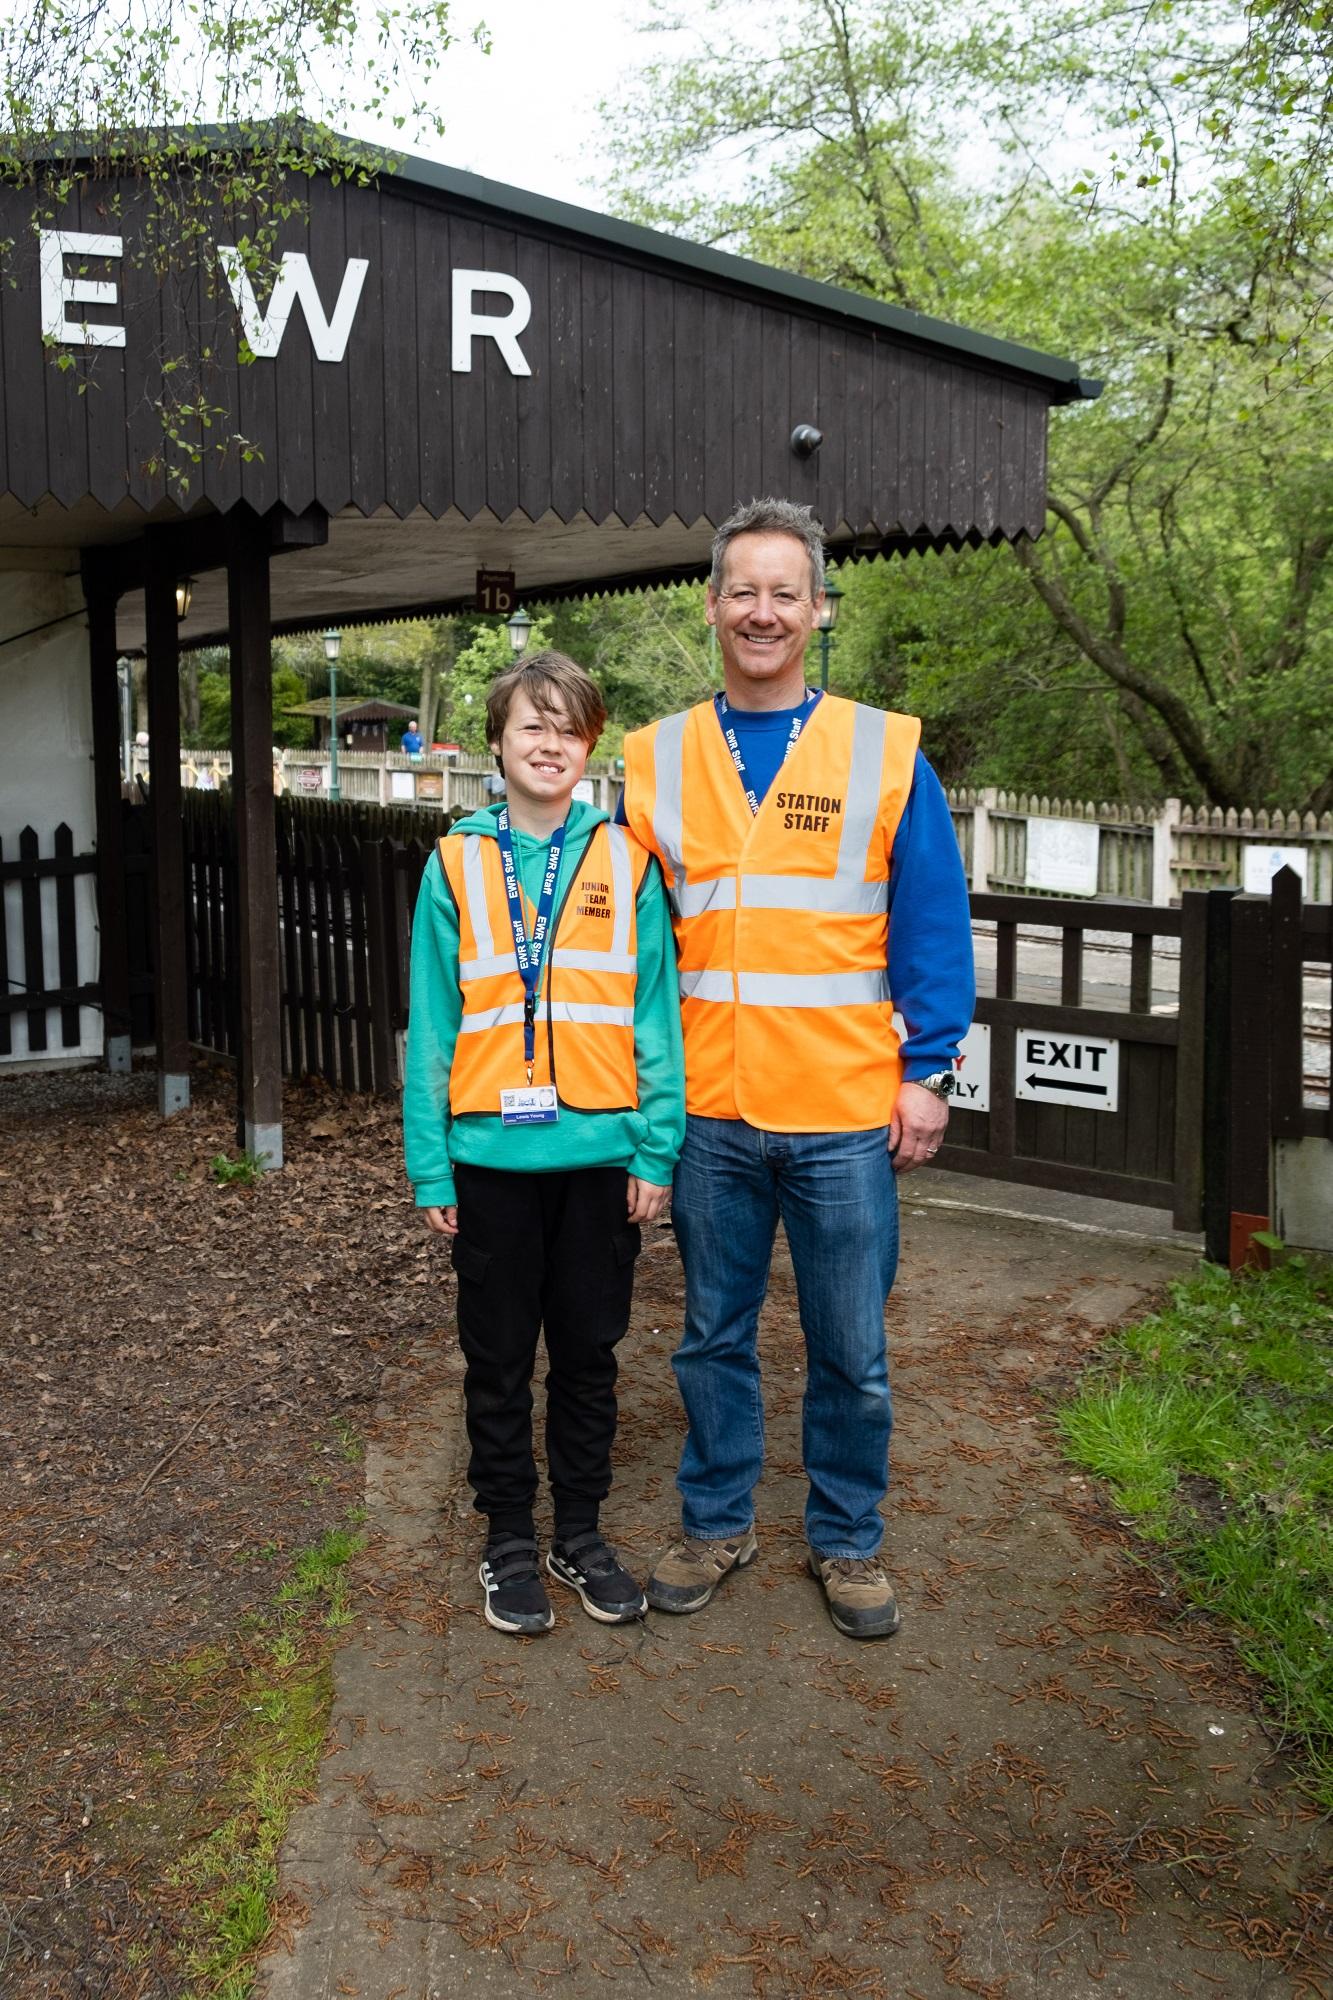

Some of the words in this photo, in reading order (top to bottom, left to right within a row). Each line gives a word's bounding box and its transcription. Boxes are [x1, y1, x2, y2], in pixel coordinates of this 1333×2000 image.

[39, 229, 126, 348] E
[217, 245, 370, 363] W
[452, 268, 533, 377] R
[481, 587, 511, 610] 1b
[790, 718, 802, 739] Staff
[726, 729, 738, 750] EWR
[732, 750, 745, 771] Staff
[776, 792, 842, 814] STATION
[784, 813, 830, 833] STAFF
[502, 851, 515, 873] Staff
[549, 846, 560, 871] EWR
[507, 875, 518, 899] EWR
[543, 872, 555, 895] Staff
[580, 881, 610, 894] JUNIOR
[583, 893, 607, 906] TEAM
[576, 905, 611, 919] MEMBER
[513, 920, 525, 943] Staff
[533, 916, 547, 940] EWR
[519, 944, 529, 970] EWR
[530, 941, 541, 966] Staff
[1026, 1038, 1108, 1072] EXIT
